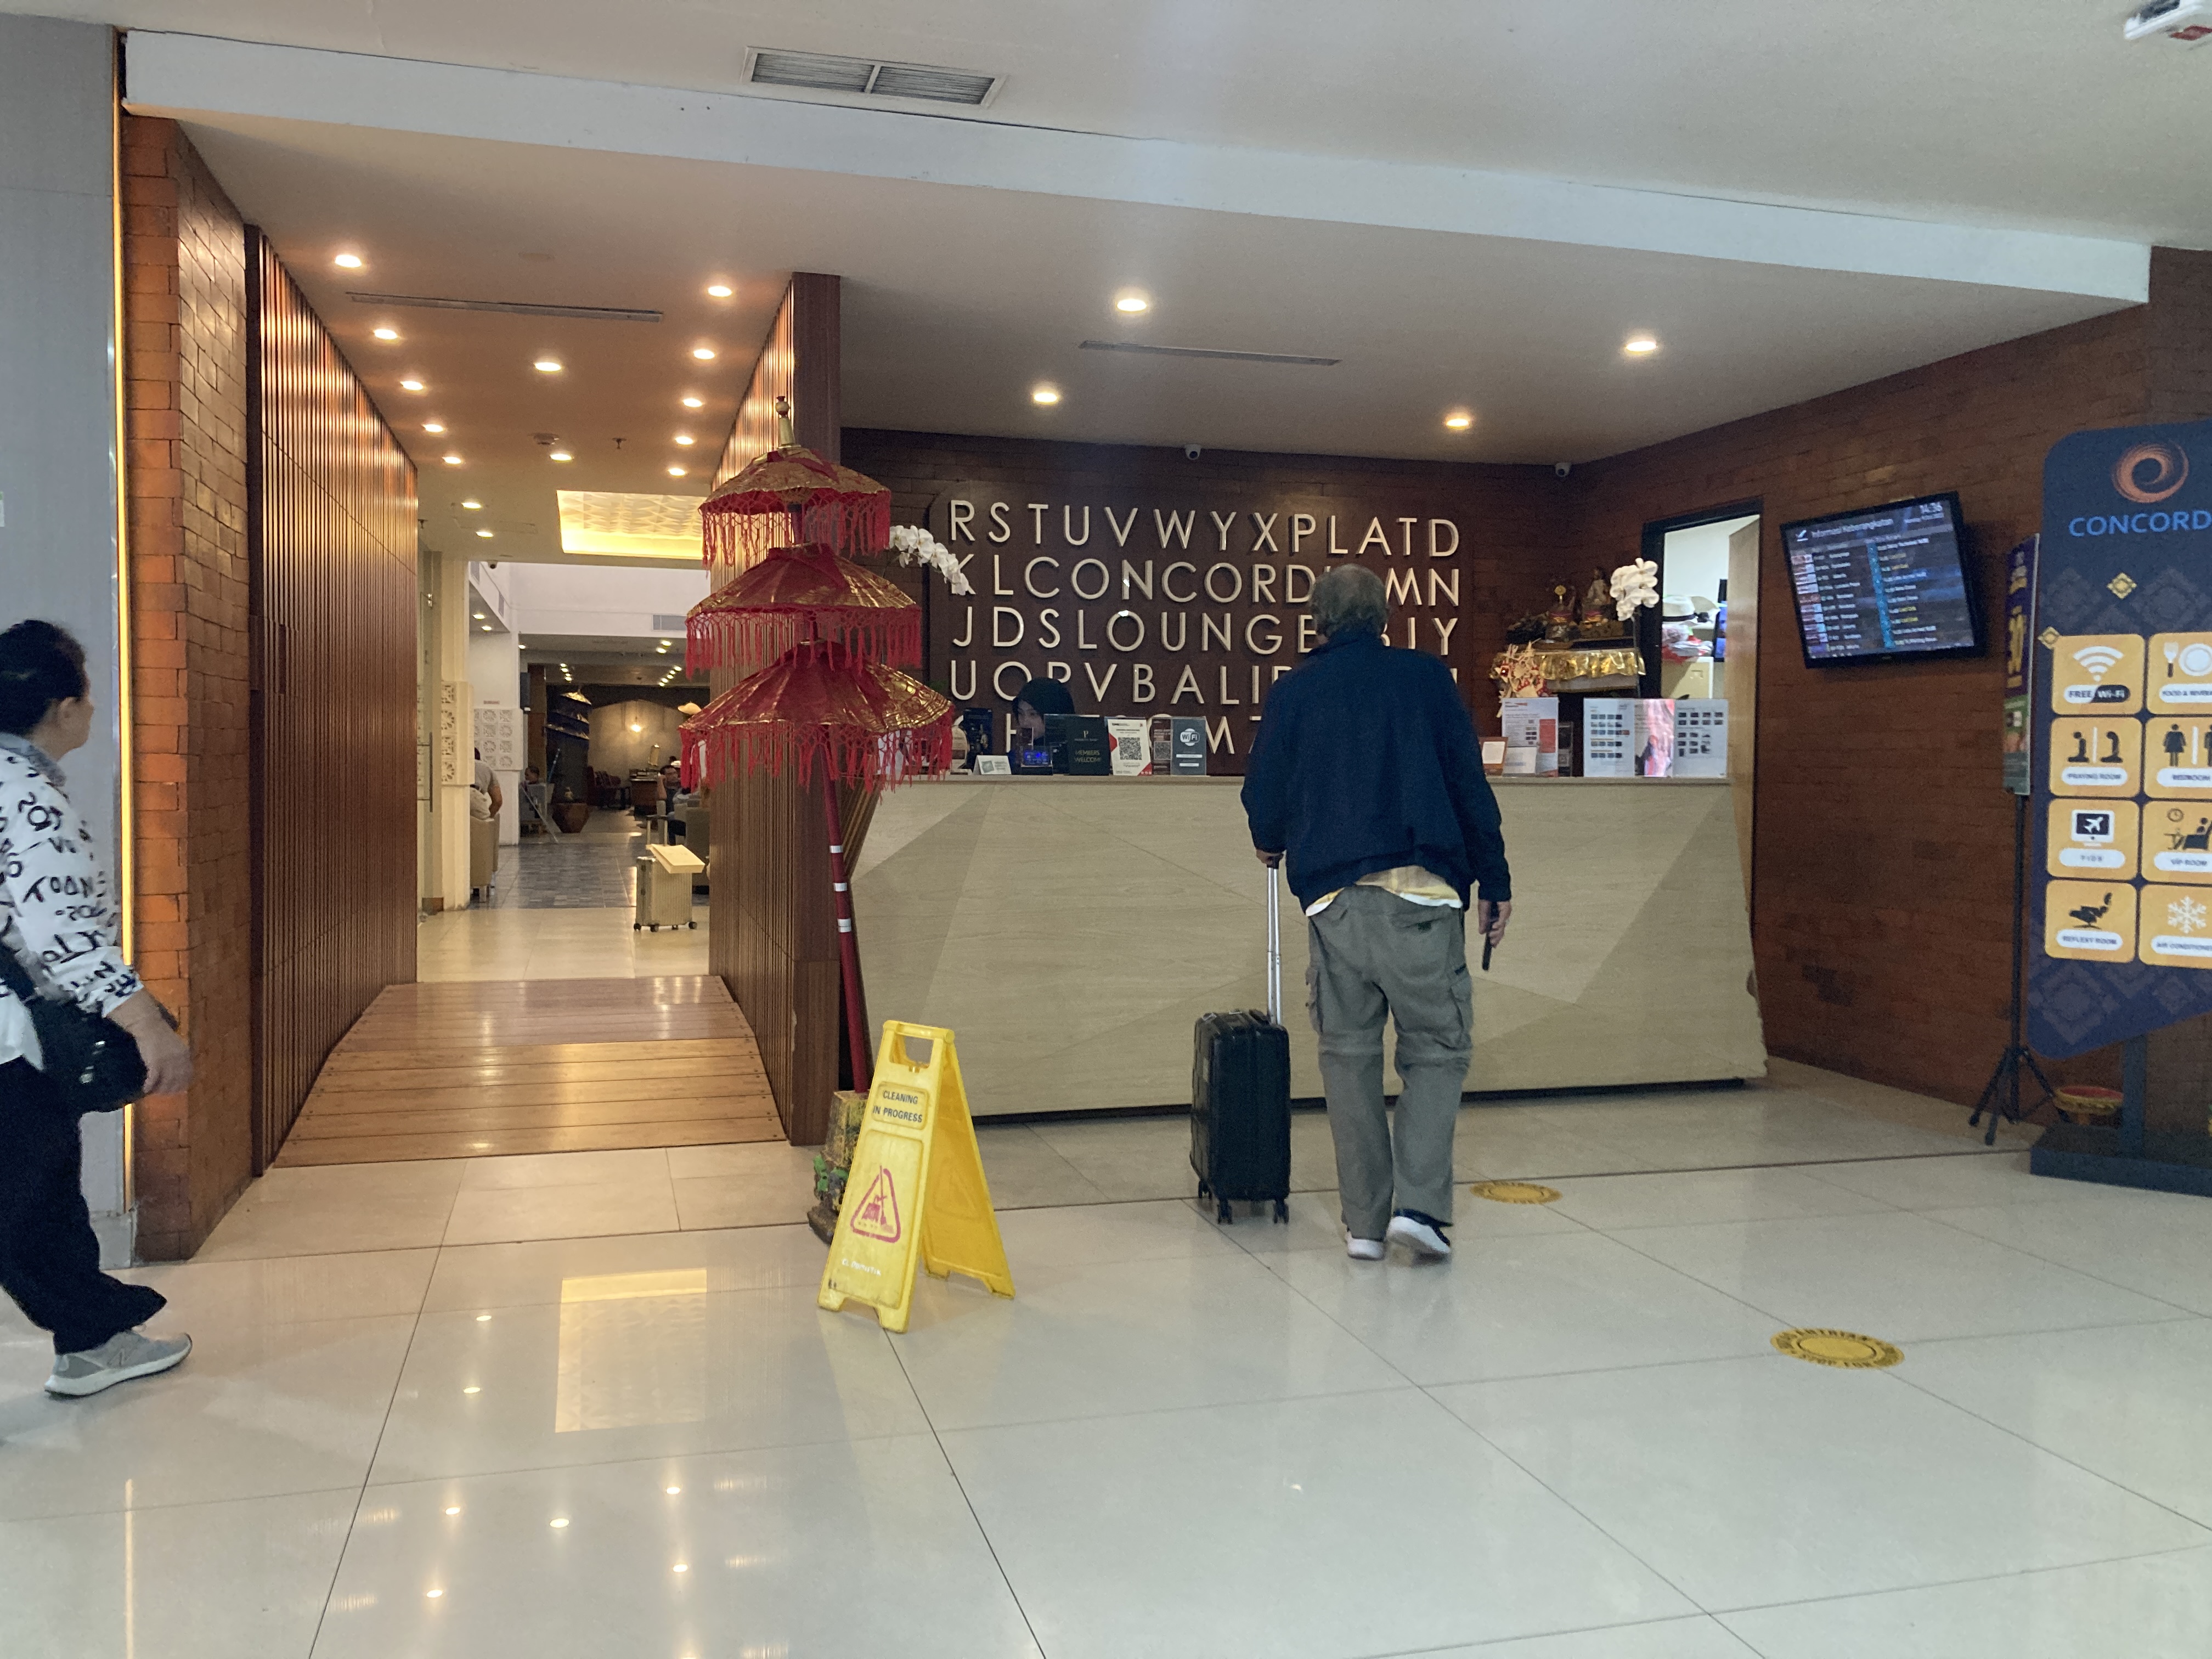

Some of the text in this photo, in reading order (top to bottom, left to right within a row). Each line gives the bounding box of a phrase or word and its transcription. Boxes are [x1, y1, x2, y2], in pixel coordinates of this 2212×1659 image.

[2068, 510, 2212, 537] CONCORD
[882, 1090, 918, 1105] CLEANING
[872, 1105, 923, 1123] IN PROGRESS
